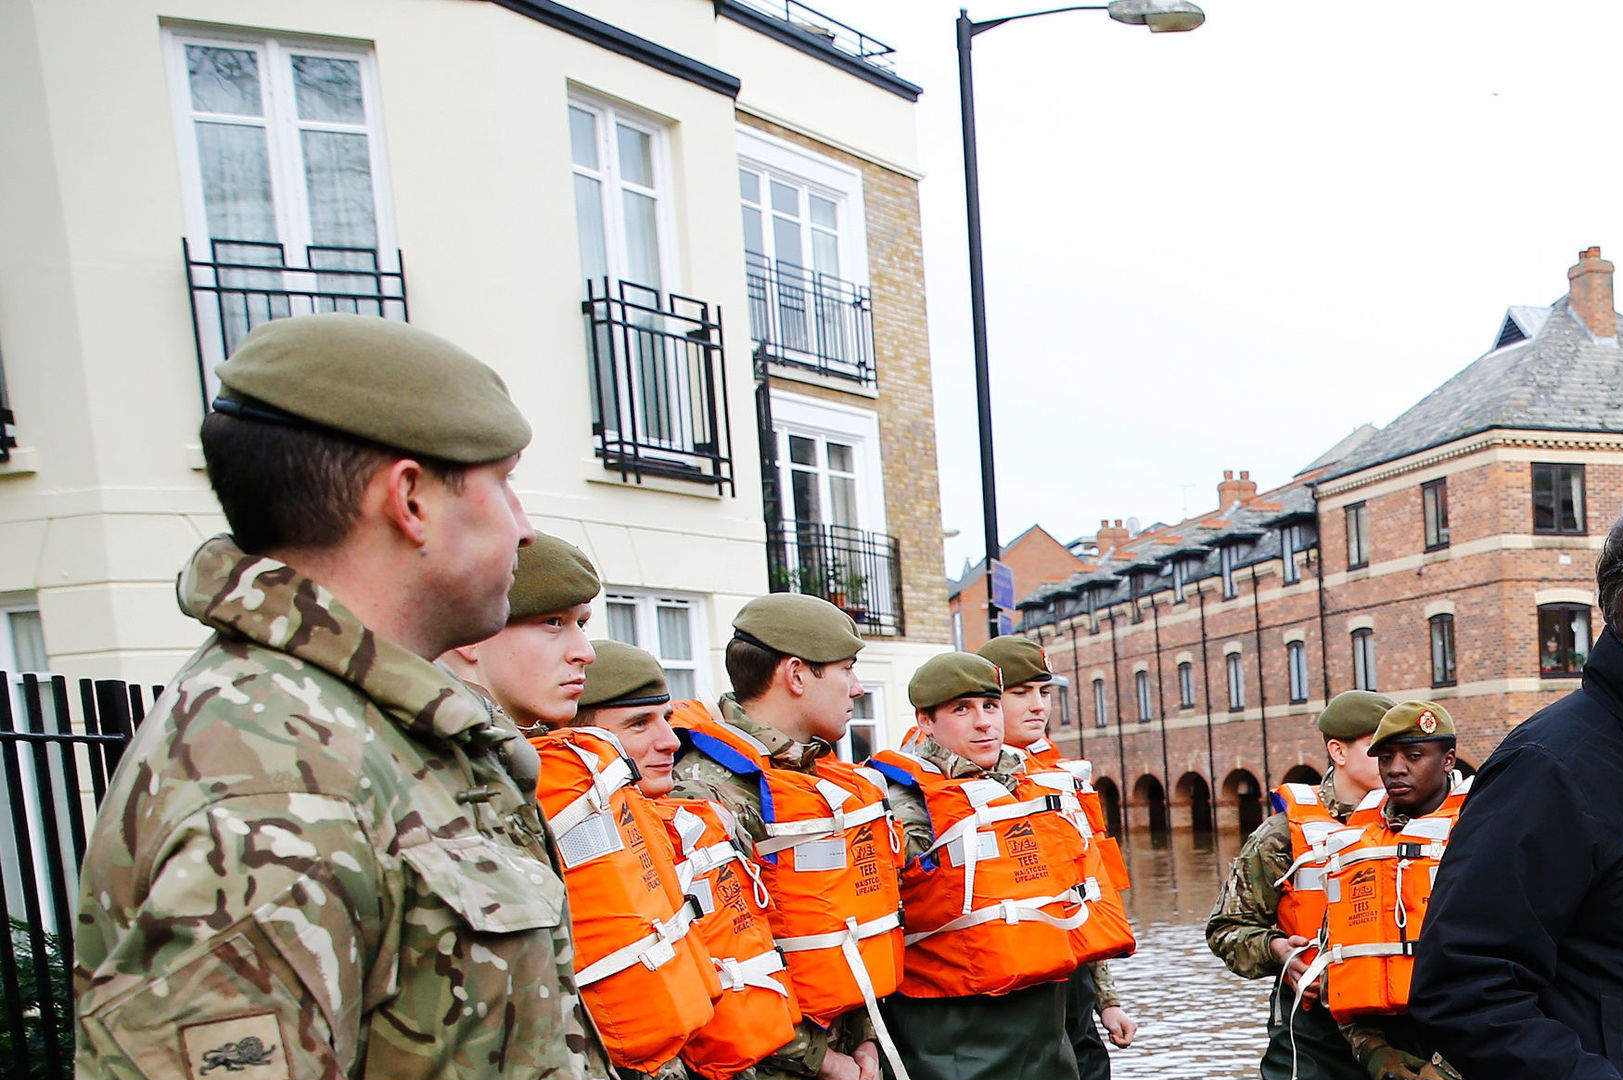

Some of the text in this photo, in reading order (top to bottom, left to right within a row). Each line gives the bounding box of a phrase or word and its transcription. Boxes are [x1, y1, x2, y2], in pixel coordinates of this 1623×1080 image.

[1018, 854, 1039, 867] TEES
[860, 863, 877, 877] TEES
[1354, 901, 1370, 913] TEES
